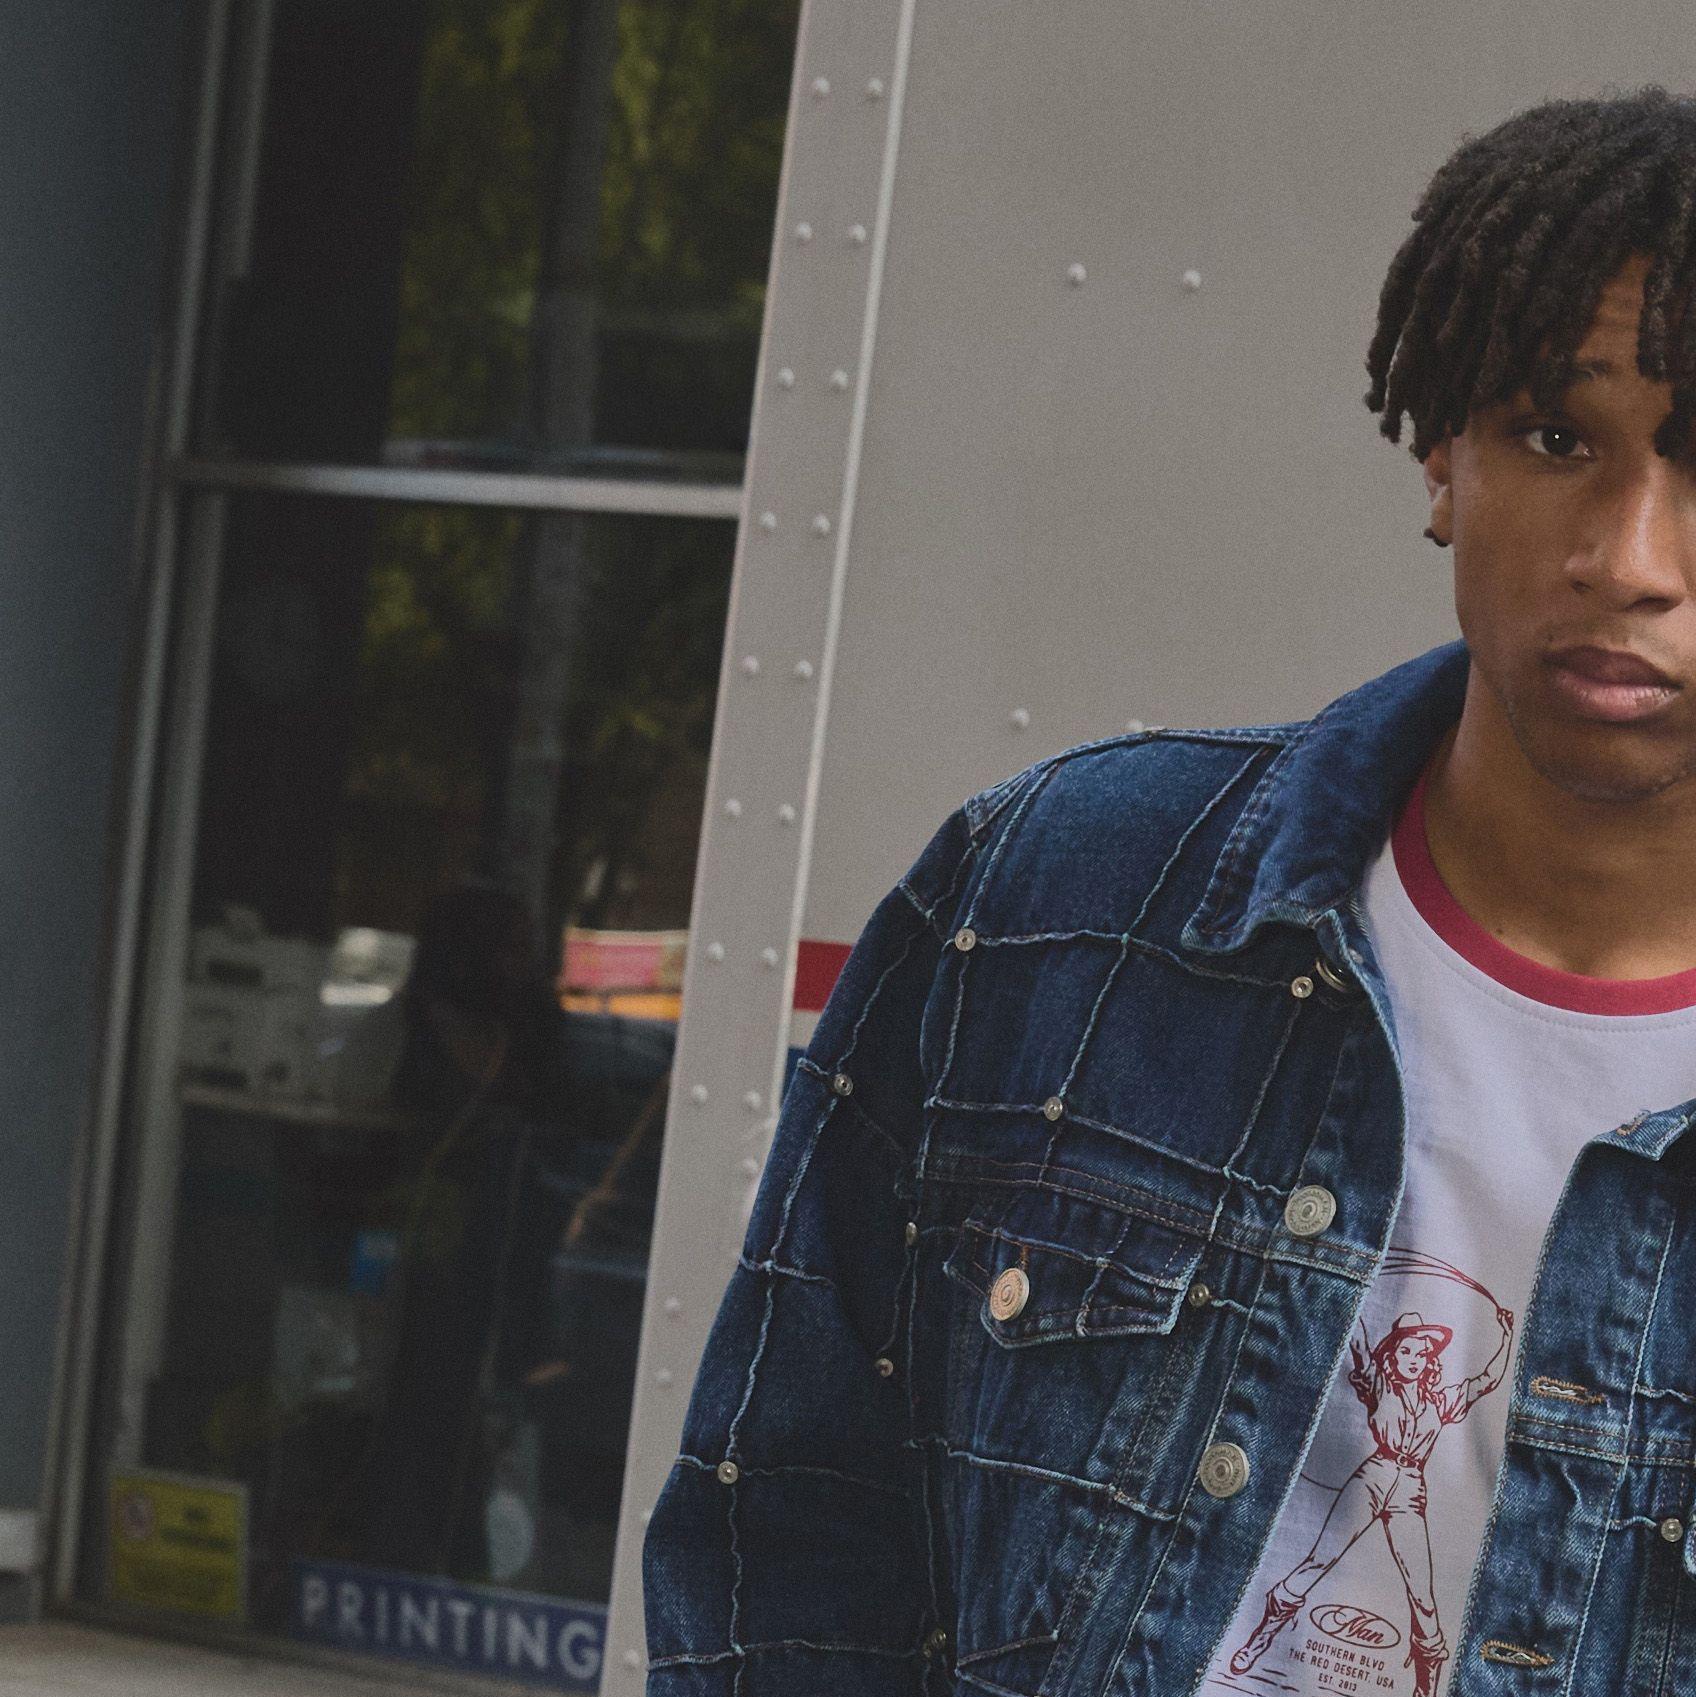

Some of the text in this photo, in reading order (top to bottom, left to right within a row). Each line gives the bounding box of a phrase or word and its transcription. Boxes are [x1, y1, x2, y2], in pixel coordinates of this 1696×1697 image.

[302, 1575, 600, 1680] PRINTING
[1320, 1608, 1384, 1644] Man
[1289, 1648, 1306, 1663] THE
[1310, 1655, 1330, 1670] RED
[1376, 1675, 1395, 1690] USA
[1305, 1638, 1385, 1671] SOUTHERN BLVD
[1338, 1679, 1357, 1692] 2013
